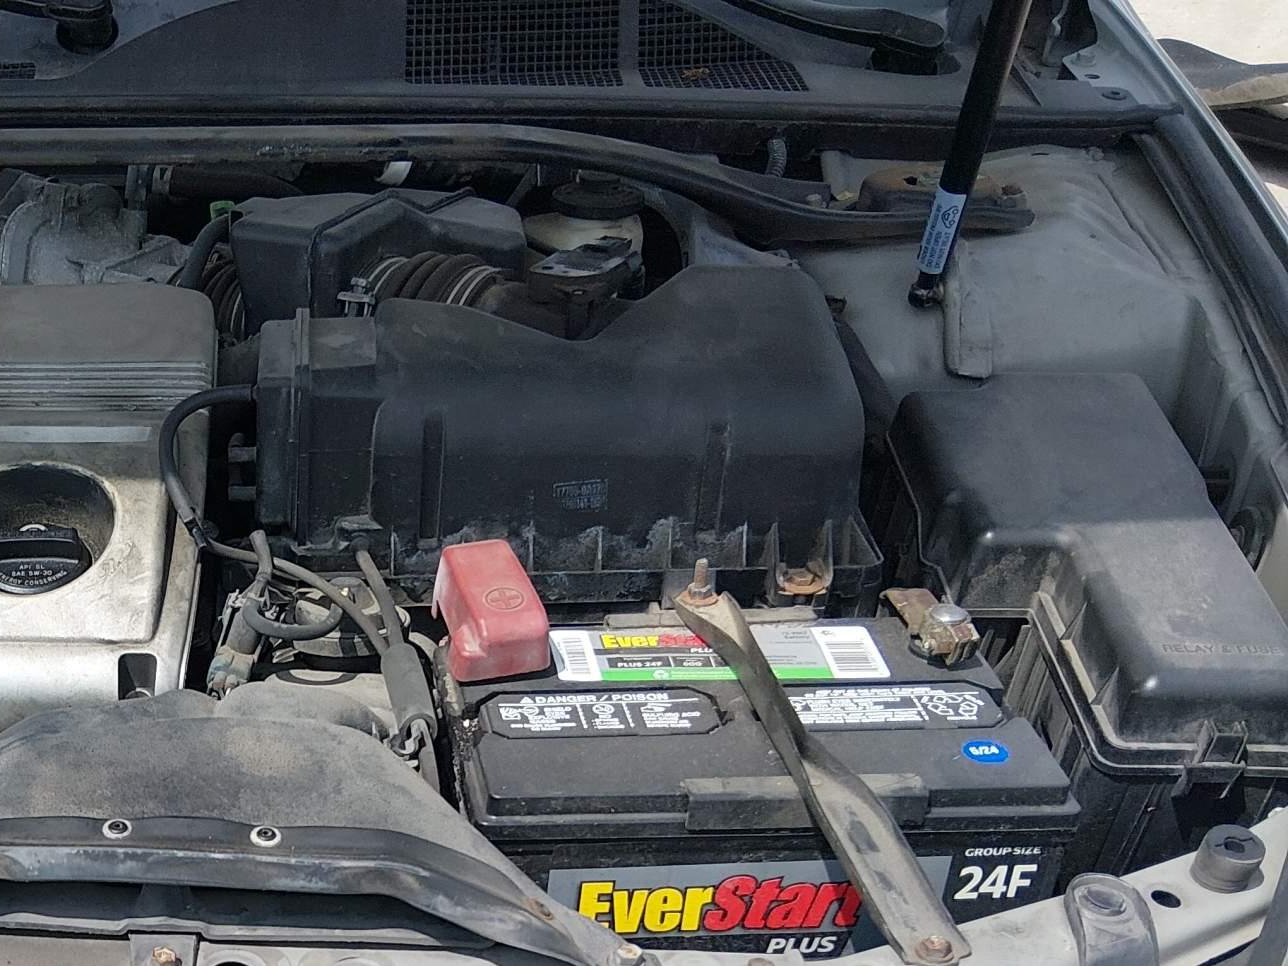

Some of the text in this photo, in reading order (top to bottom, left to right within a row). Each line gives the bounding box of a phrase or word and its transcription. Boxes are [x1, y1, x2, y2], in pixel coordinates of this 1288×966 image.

[535, 694, 597, 704] DANGER
[611, 692, 669, 702] POISON
[964, 846, 1042, 857] GROUP SIZE
[953, 863, 1038, 900] 24F
[577, 874, 862, 934] EverStart
[765, 936, 838, 955] PLUS
